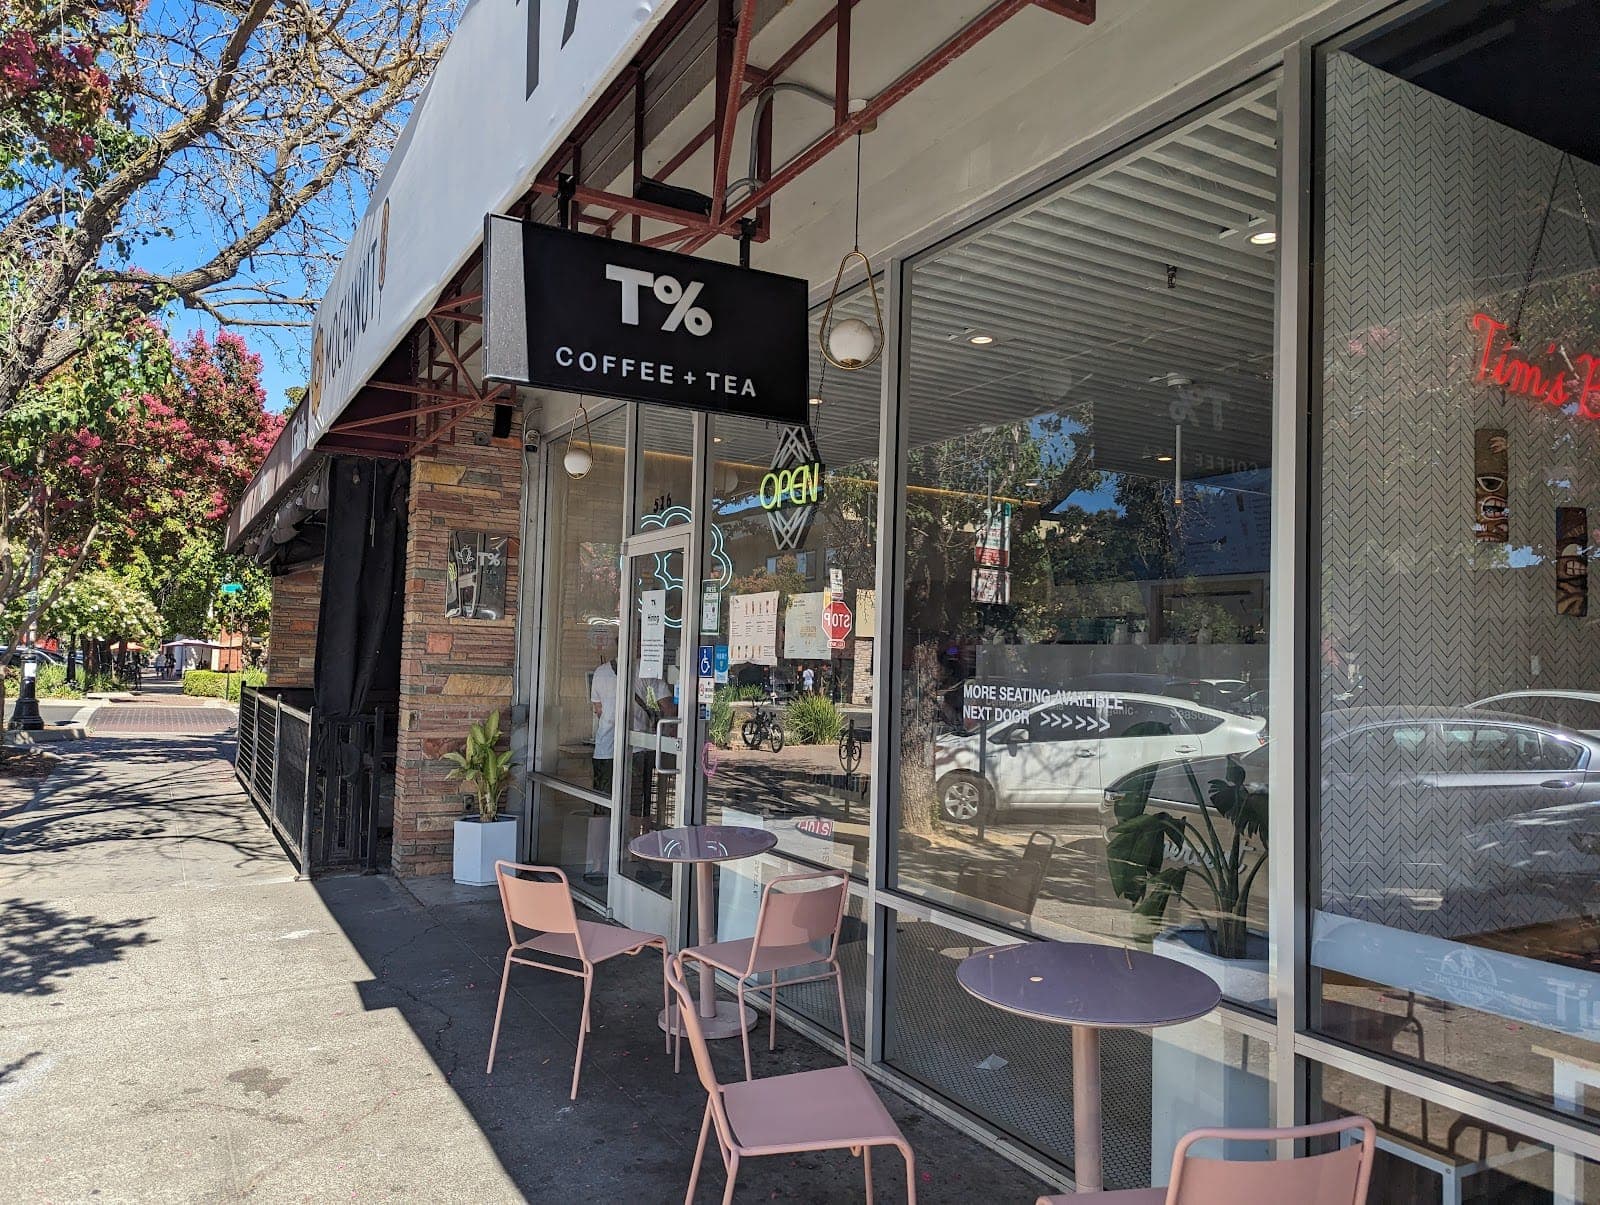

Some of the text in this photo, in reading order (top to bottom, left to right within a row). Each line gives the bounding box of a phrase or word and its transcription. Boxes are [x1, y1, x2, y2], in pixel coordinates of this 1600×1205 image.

[325, 237, 378, 391] MOCHINUT
[606, 264, 713, 337] T%
[555, 347, 757, 398] COFFEE + TEA
[1473, 313, 1569, 406] Tim's
[653, 492, 672, 514] 516
[759, 462, 820, 510] OPEN
[963, 684, 997, 700] MORE
[999, 686, 1051, 705] SEATING
[963, 705, 1030, 725] NEXT DOOR
